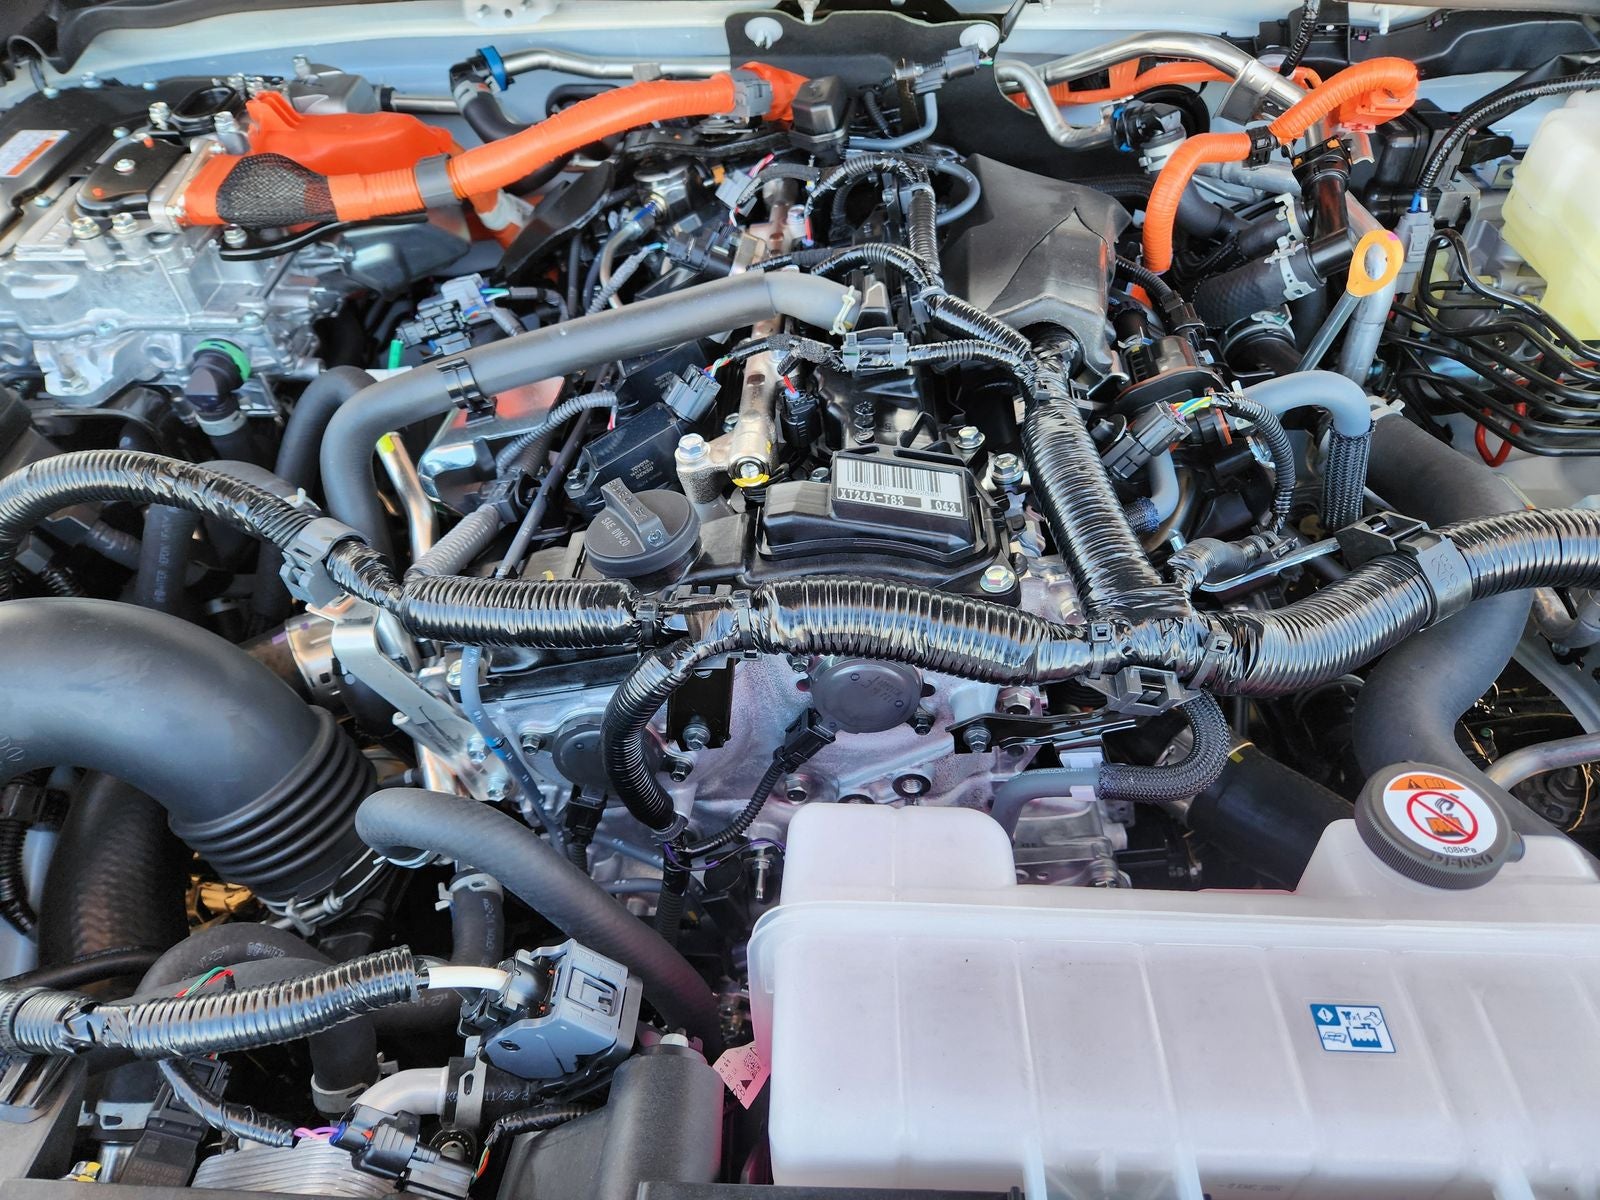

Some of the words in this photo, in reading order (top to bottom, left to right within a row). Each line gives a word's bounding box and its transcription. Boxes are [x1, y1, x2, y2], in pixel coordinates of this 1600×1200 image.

[635, 466, 654, 480] DENSO
[839, 488, 905, 506] XT24A-T83
[935, 502, 957, 512] 043
[601, 517, 616, 531] SAE
[612, 528, 632, 547] 0W-20
[1442, 846, 1477, 854] 108kPa
[1432, 853, 1494, 868] DENSO
